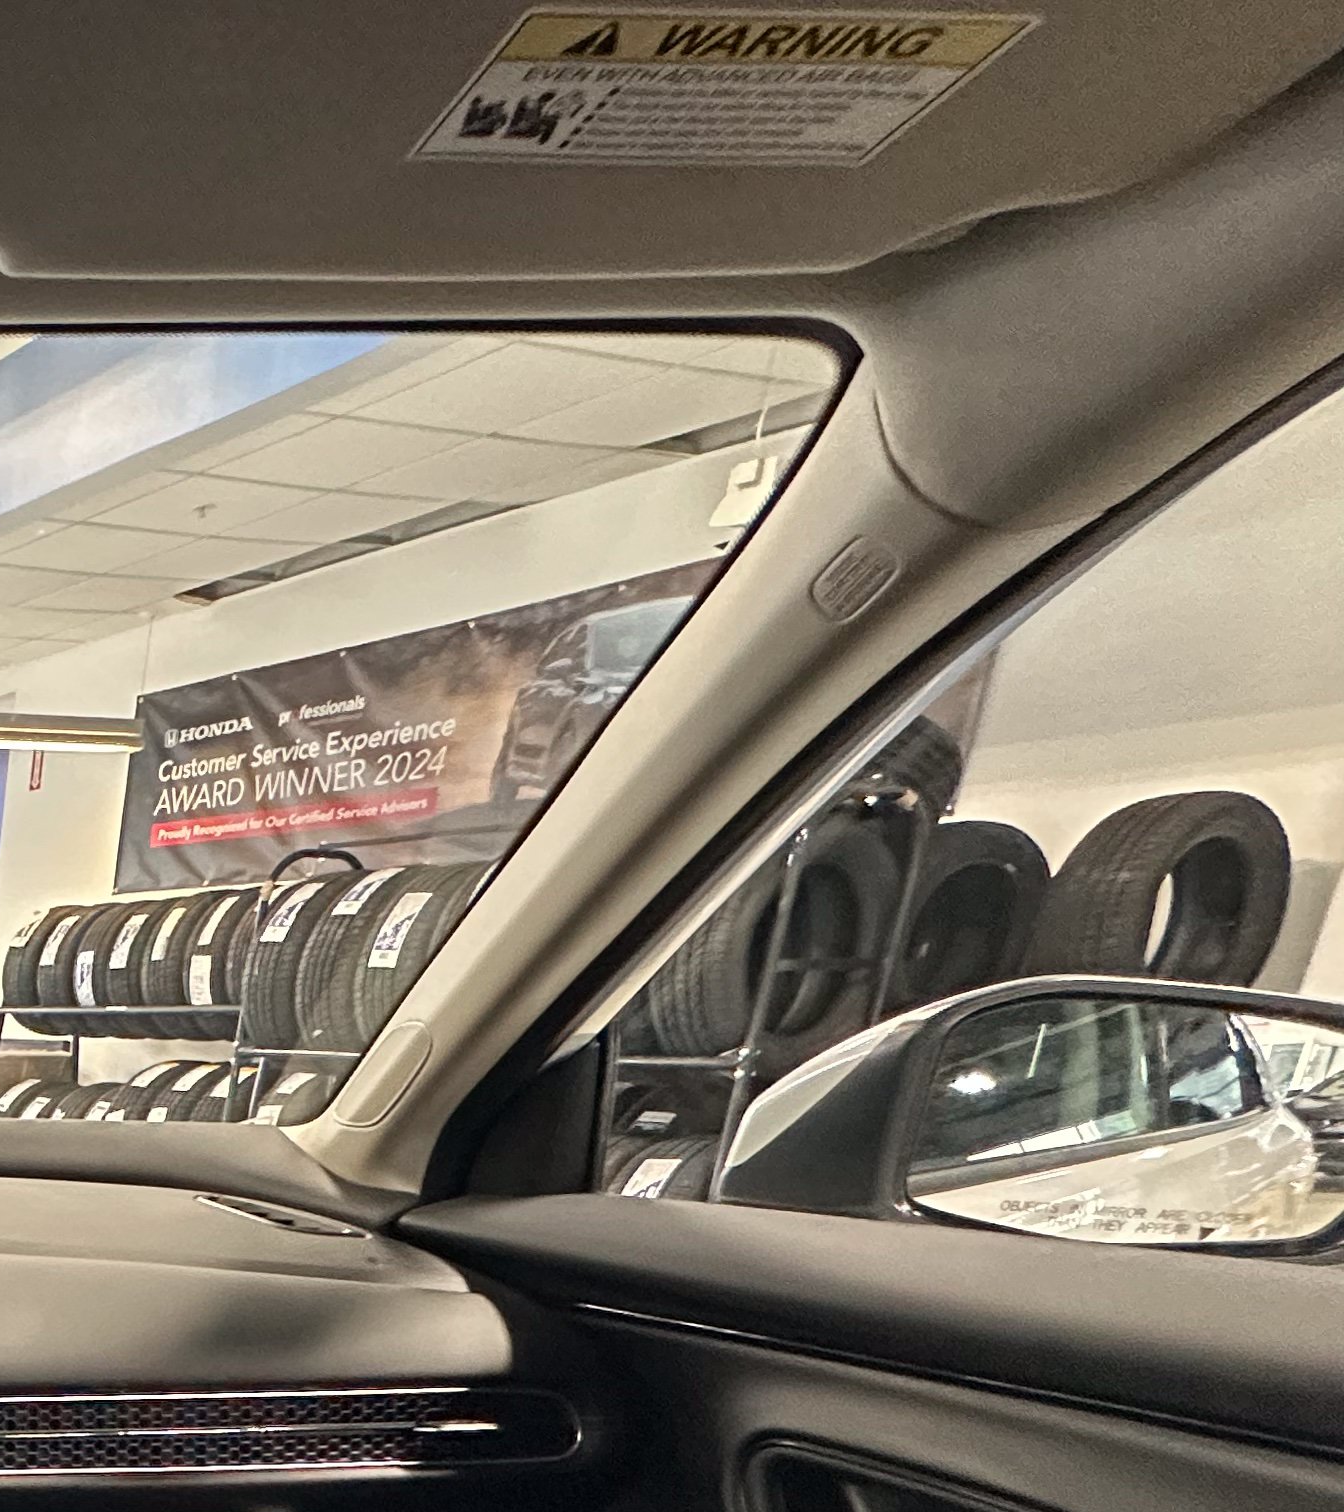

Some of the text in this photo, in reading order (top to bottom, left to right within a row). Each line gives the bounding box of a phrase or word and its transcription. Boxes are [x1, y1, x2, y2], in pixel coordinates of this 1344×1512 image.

[656, 23, 944, 58] WARNING
[158, 716, 457, 783] Customer Service Experience
[179, 716, 253, 743] HONDA
[153, 745, 448, 816] AWARD WINNER 2024
[157, 798, 429, 841] Proudly Recognized for Our Certified Service Advisors
